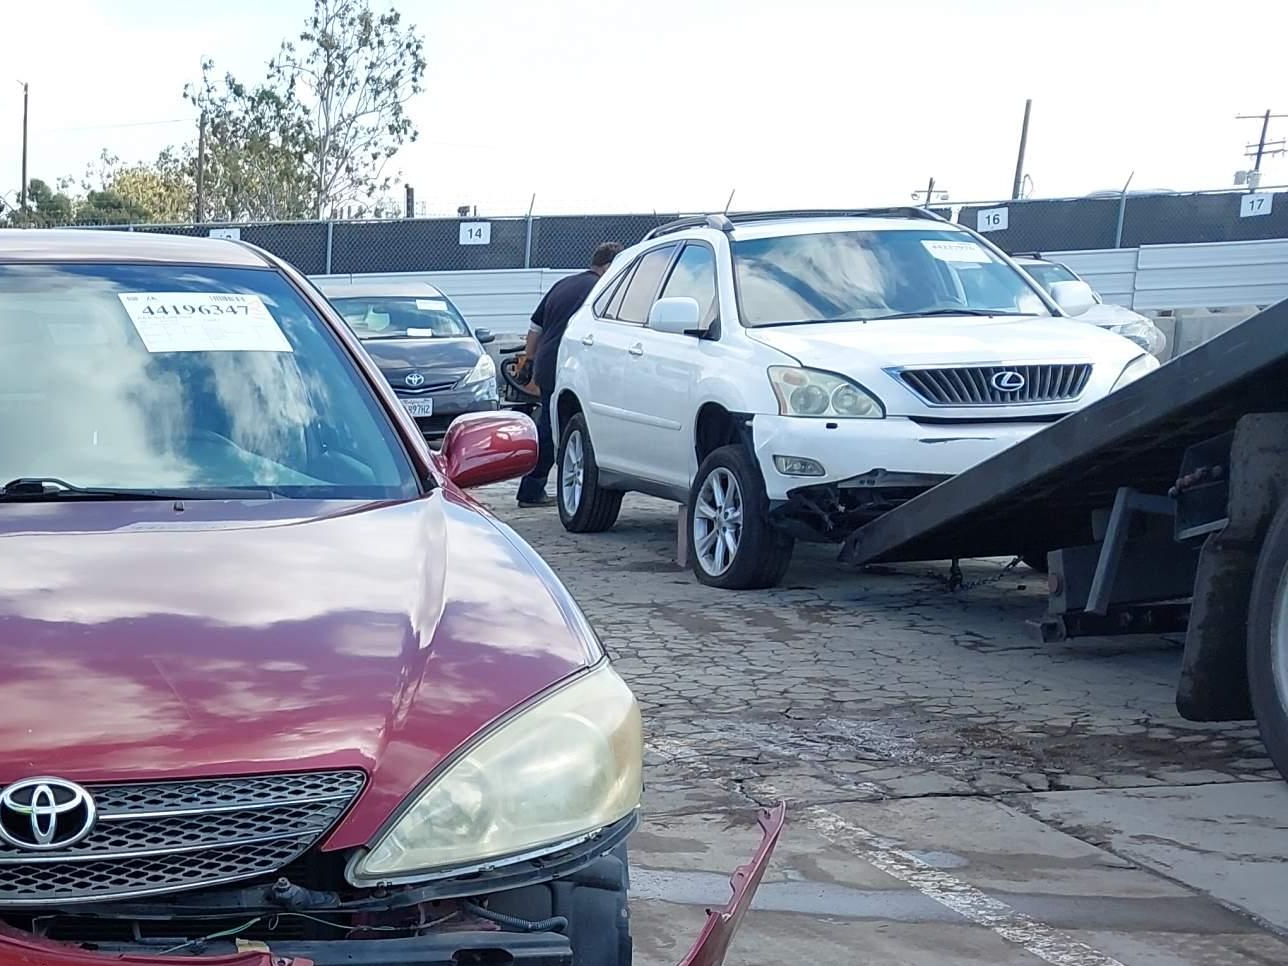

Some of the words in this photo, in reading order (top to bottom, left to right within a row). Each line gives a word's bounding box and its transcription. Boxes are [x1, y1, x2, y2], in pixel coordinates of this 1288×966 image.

[1249, 198, 1265, 211] 17
[985, 213, 1000, 226] 16
[467, 227, 482, 240] 14
[142, 304, 250, 317] 44196347
